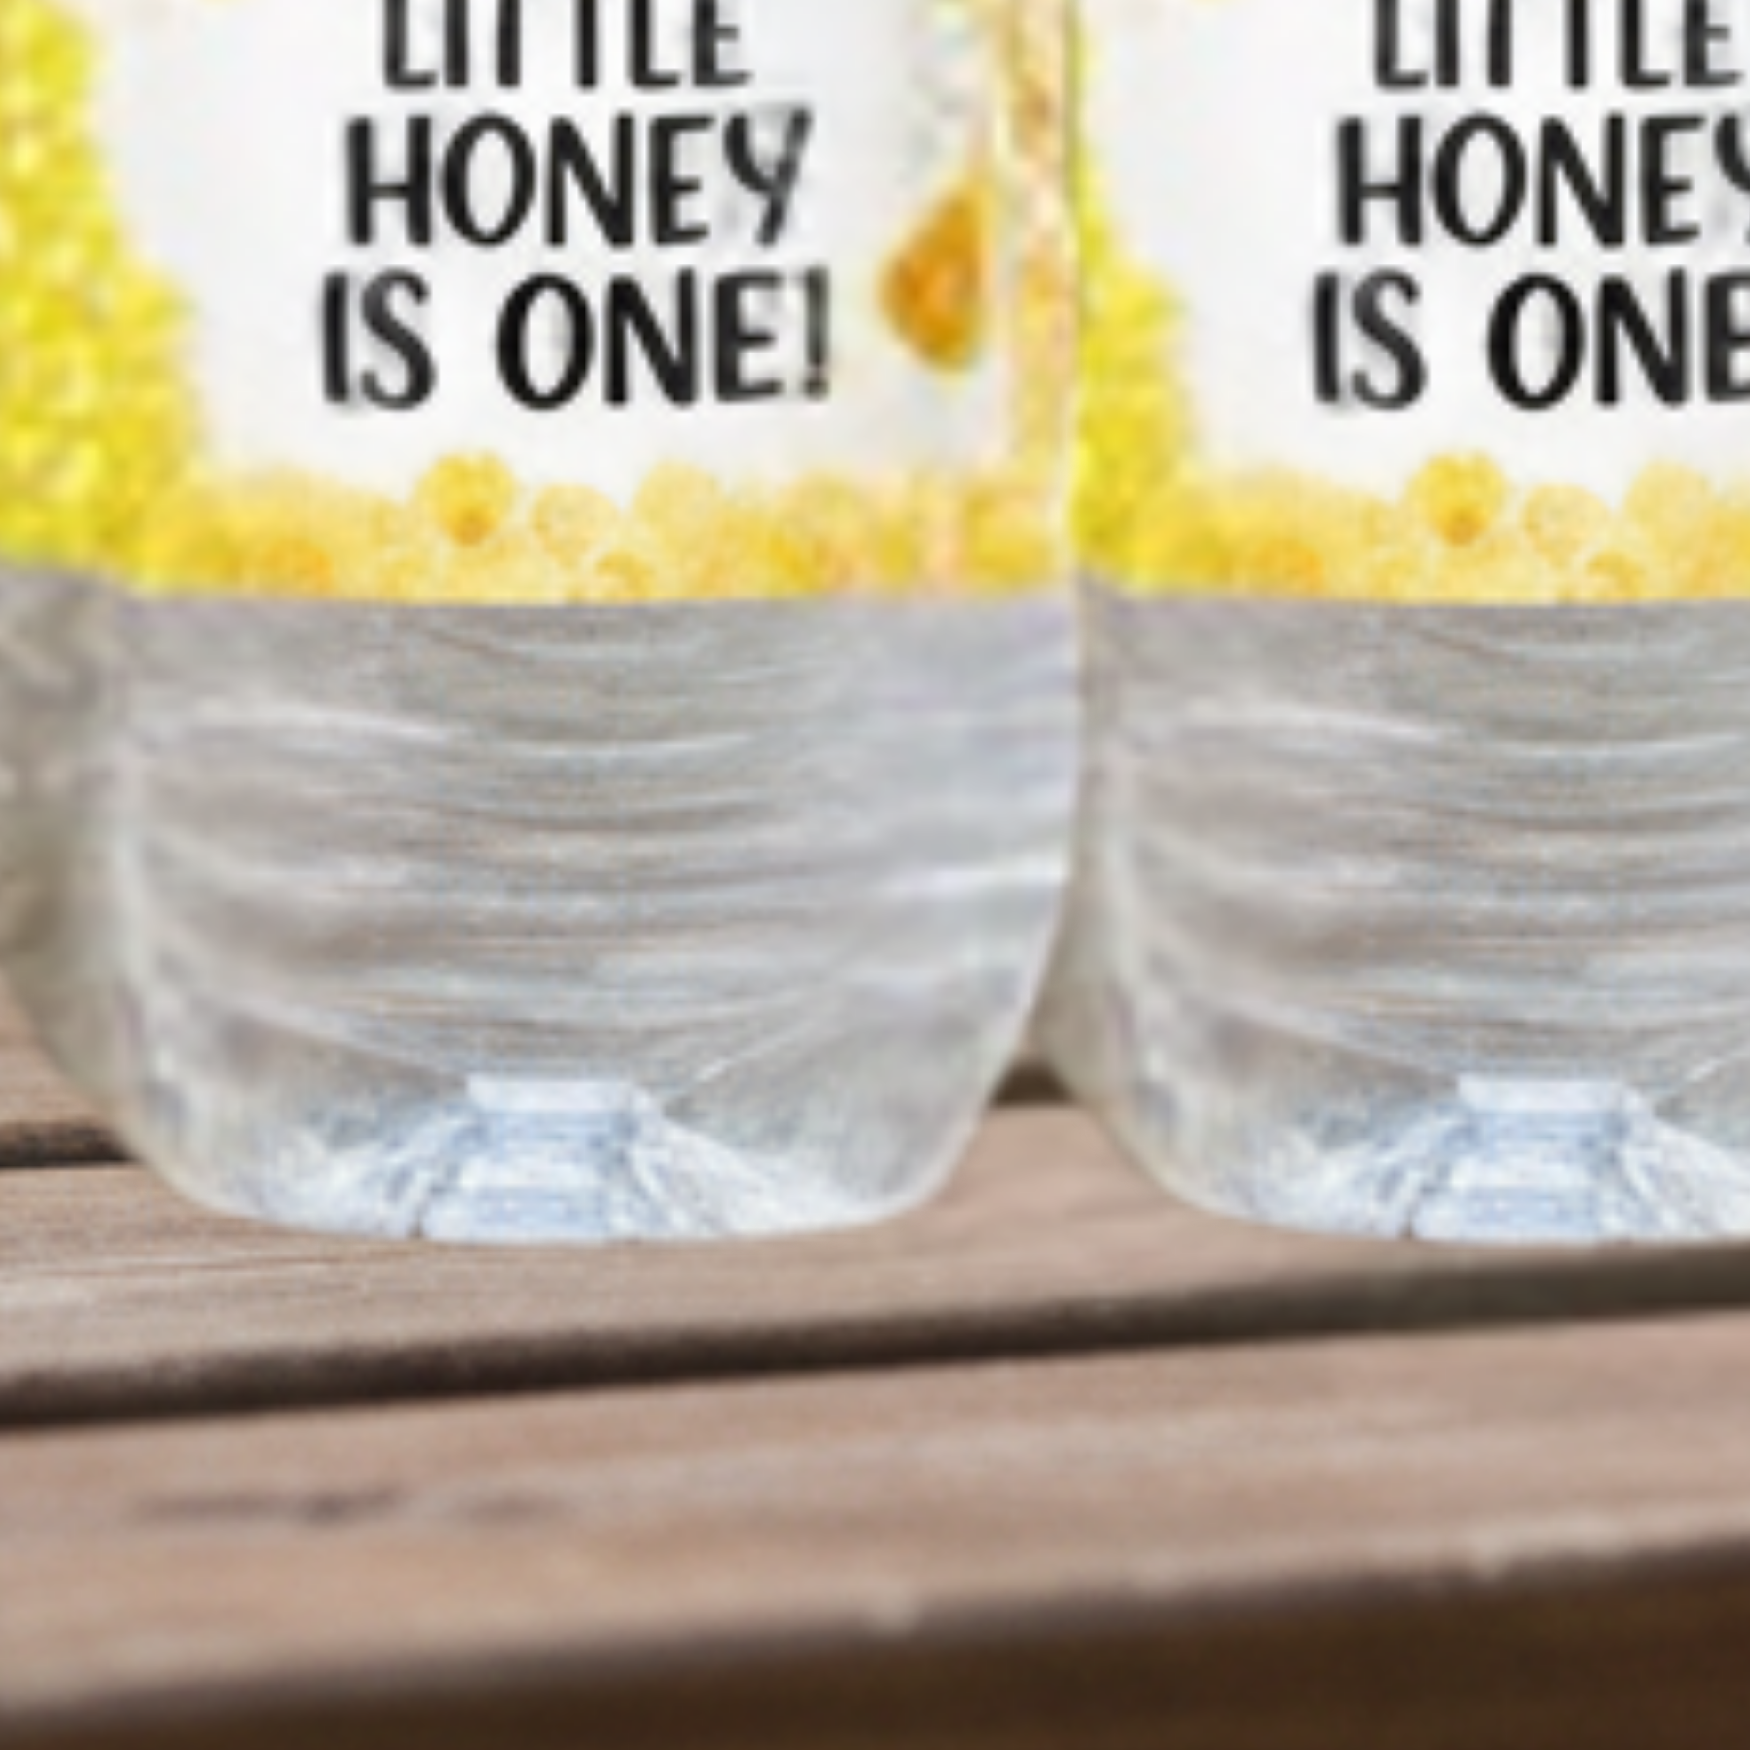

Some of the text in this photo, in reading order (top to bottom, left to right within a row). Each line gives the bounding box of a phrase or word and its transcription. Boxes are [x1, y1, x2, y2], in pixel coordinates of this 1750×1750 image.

[345, 108, 813, 249] HONEY
[321, 268, 829, 411] IS ONE!
[1312, 269, 1427, 410] IS
